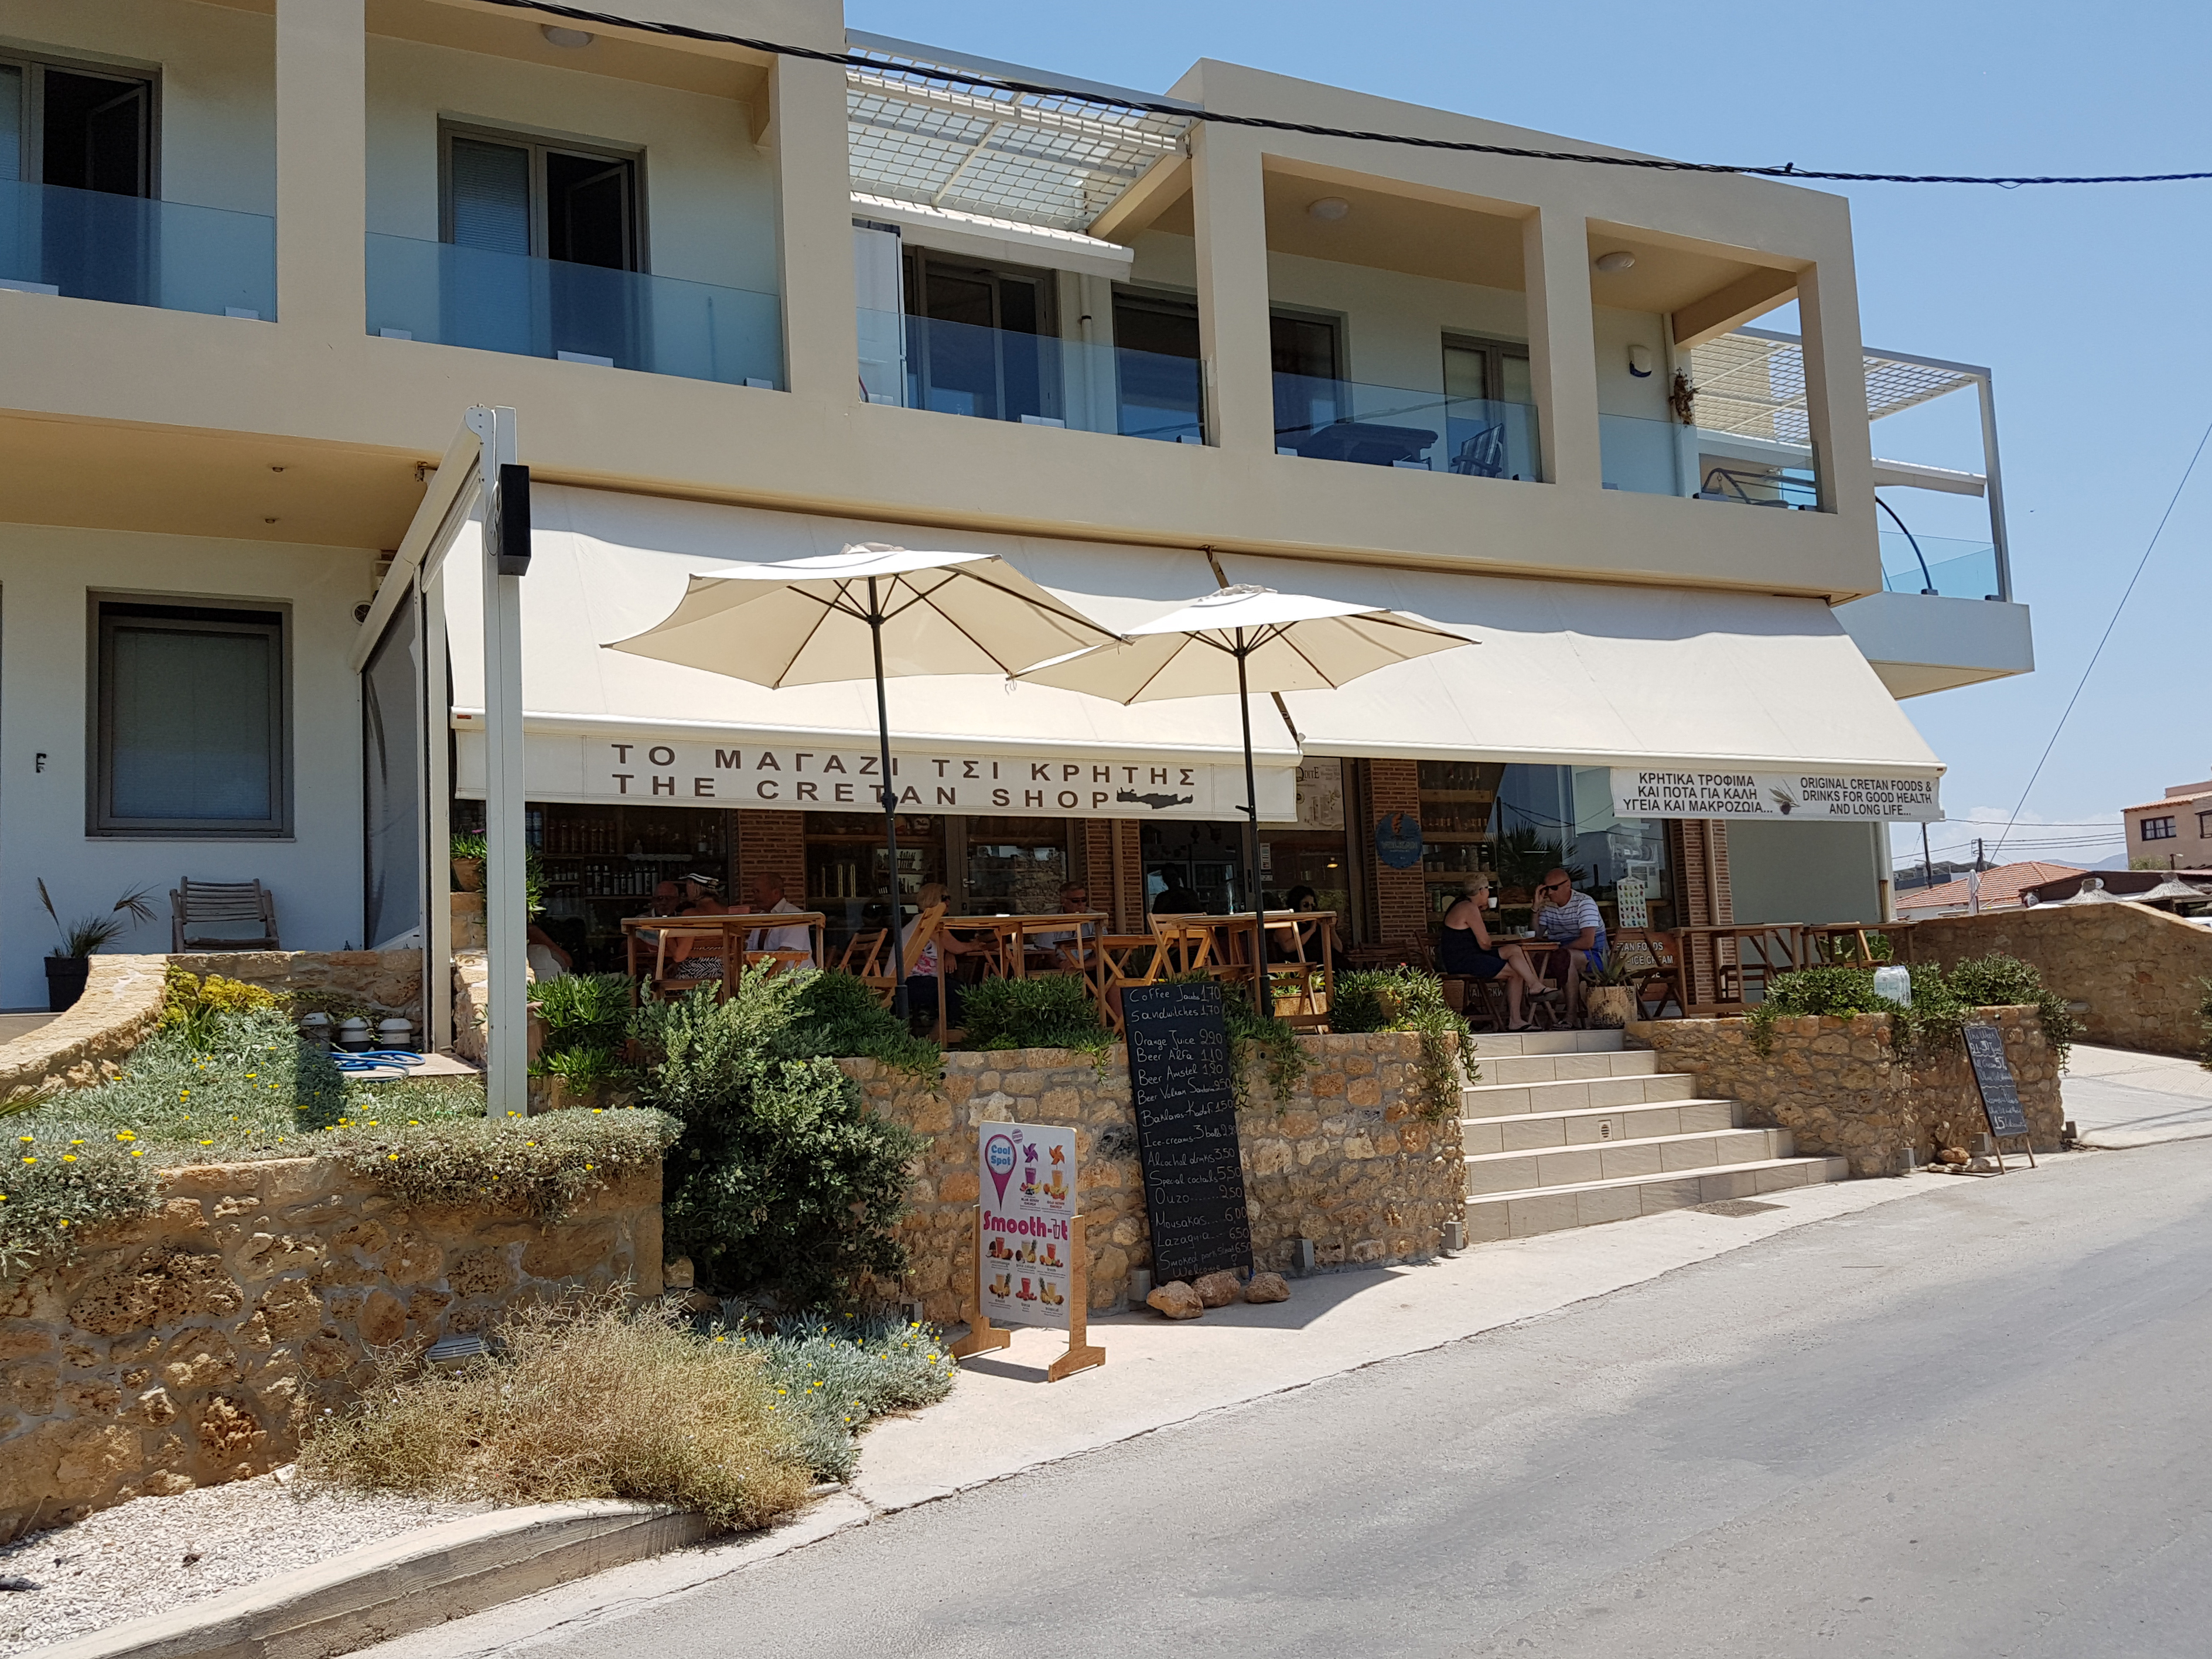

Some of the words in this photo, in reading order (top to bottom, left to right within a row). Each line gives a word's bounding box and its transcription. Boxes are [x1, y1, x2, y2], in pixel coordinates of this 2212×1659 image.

[611, 743, 676, 766] ΤΟ
[715, 749, 899, 776] ΜΑΓΑΖΙ
[932, 759, 999, 780] ΤΣΙ
[1031, 763, 1195, 786] ΚΡΗΤΗΣ
[1638, 772, 1695, 786] ΚΡΗΤΙΚΑ
[1698, 774, 1755, 787] ΤΡΟΦΙΜΑ
[1800, 777, 1849, 790] ORIGINAL
[1850, 779, 1889, 791] CRETAN
[1892, 780, 1923, 791] FOODS
[1926, 781, 1932, 791] &
[612, 773, 716, 797] THE
[757, 779, 957, 805] CRETAN
[992, 788, 1109, 809] SHOP
[1638, 786, 1660, 798] ΚΑΙ
[1663, 786, 1697, 798] ΠΟΤΑ
[1701, 788, 1721, 799] ΓΙΑ
[1723, 788, 1757, 800] ΚΑΛΗ
[1803, 790, 1841, 802] DRINKS
[1844, 791, 1863, 803] FOR
[1866, 791, 1894, 803] GOOD
[1897, 793, 1933, 804] HEALTH
[1623, 798, 1661, 811] ΥΓΕΙΑ
[1664, 800, 1685, 811] ΚΑΙ
[1829, 803, 1851, 814] AND
[1853, 804, 1880, 815] LONG
[1883, 805, 1911, 815] LIFE...
[1637, 941, 1664, 951] FODS
[1631, 955, 1644, 965] ICE
[1134, 1030, 1168, 1051] Orange
[1169, 1030, 1196, 1050] Juice
[1136, 1047, 1162, 1063] Beer
[1138, 1069, 1162, 1086] Beer
[1167, 1064, 1198, 1081] Amstel
[1138, 1090, 1158, 1105] Beer
[991, 1145, 1011, 1155] Cool
[991, 1155, 1011, 1166] Spot
[1149, 1170, 1184, 1187] Special
[1159, 1250, 1199, 1271] Smoked
[1173, 1264, 1221, 1278] Welcome
